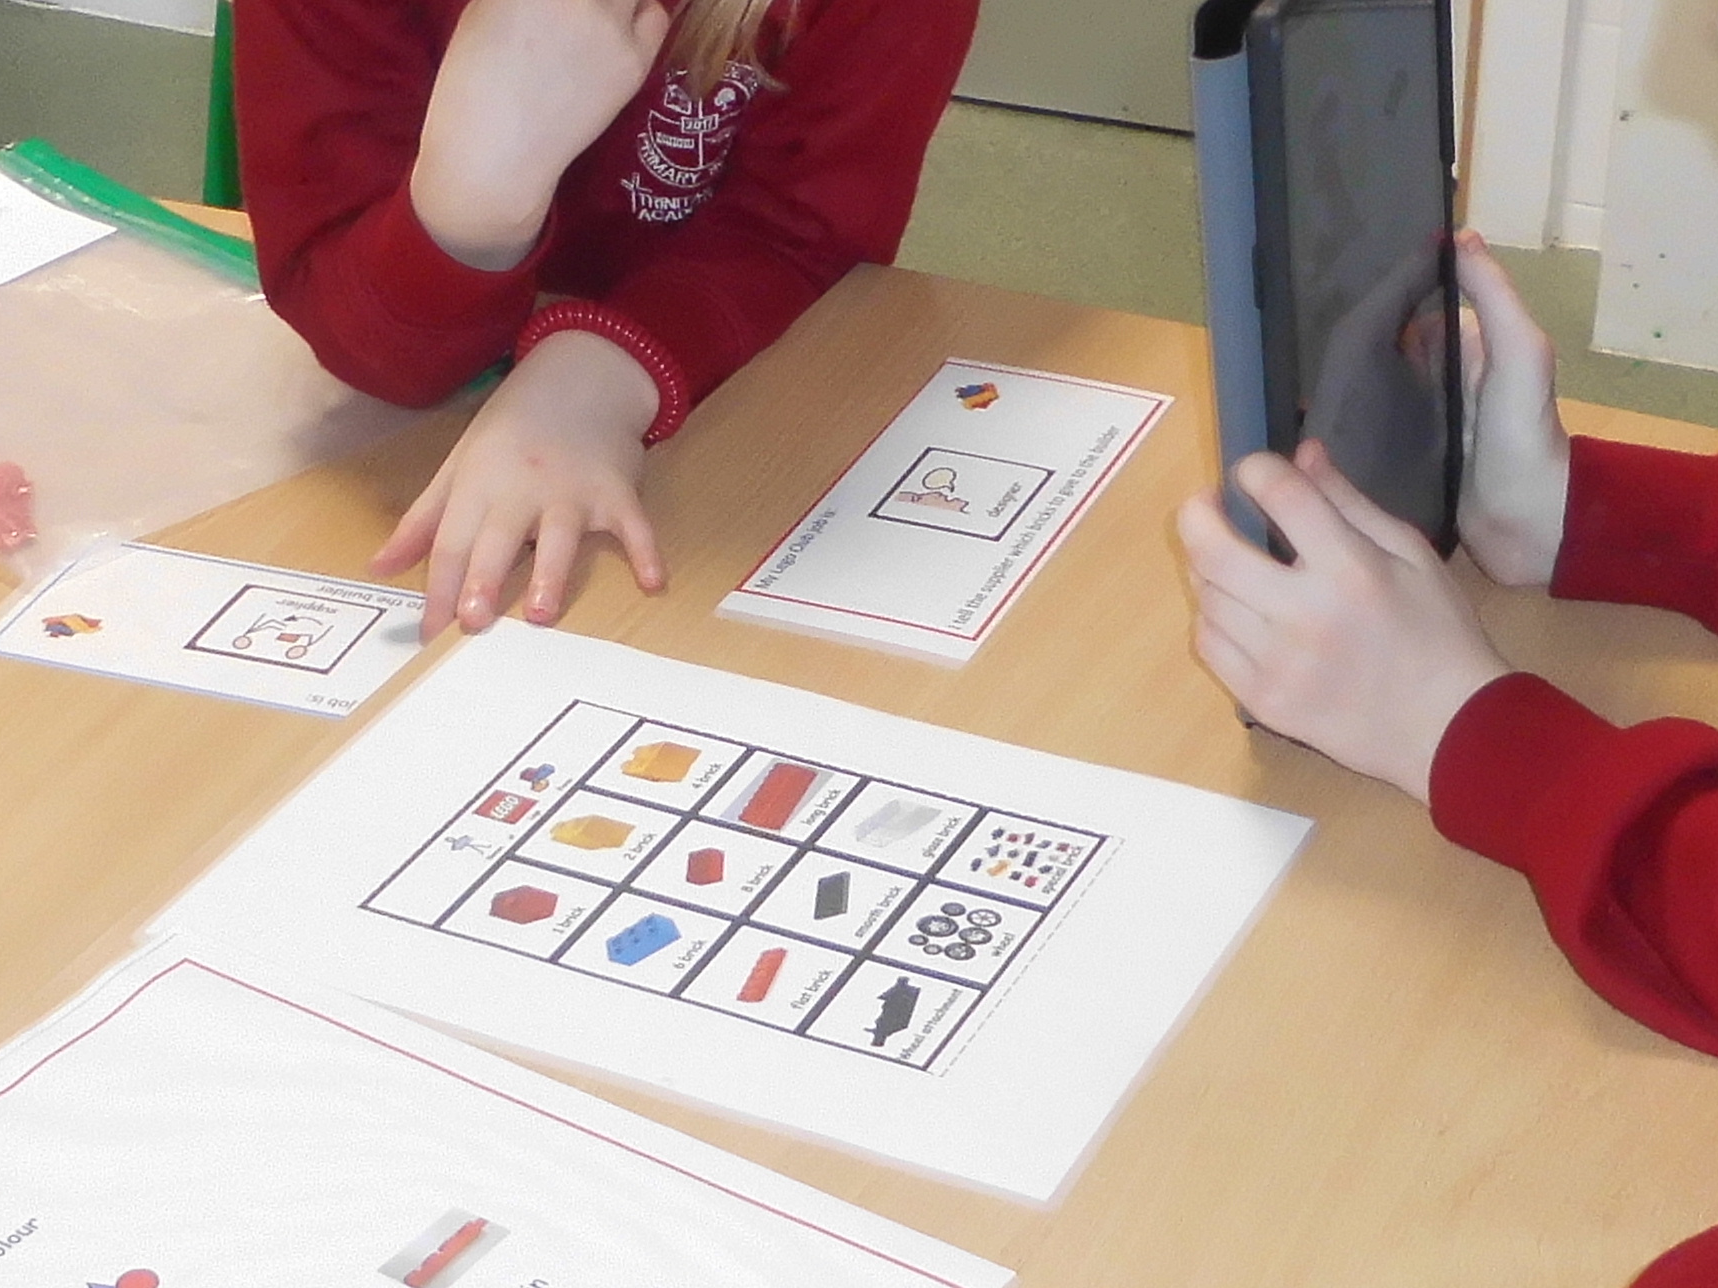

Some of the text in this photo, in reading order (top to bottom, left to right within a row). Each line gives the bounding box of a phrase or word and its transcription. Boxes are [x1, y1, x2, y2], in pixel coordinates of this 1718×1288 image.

[697, 762, 722, 787] brick
[632, 831, 658, 856] brick
[560, 905, 586, 932] brick
